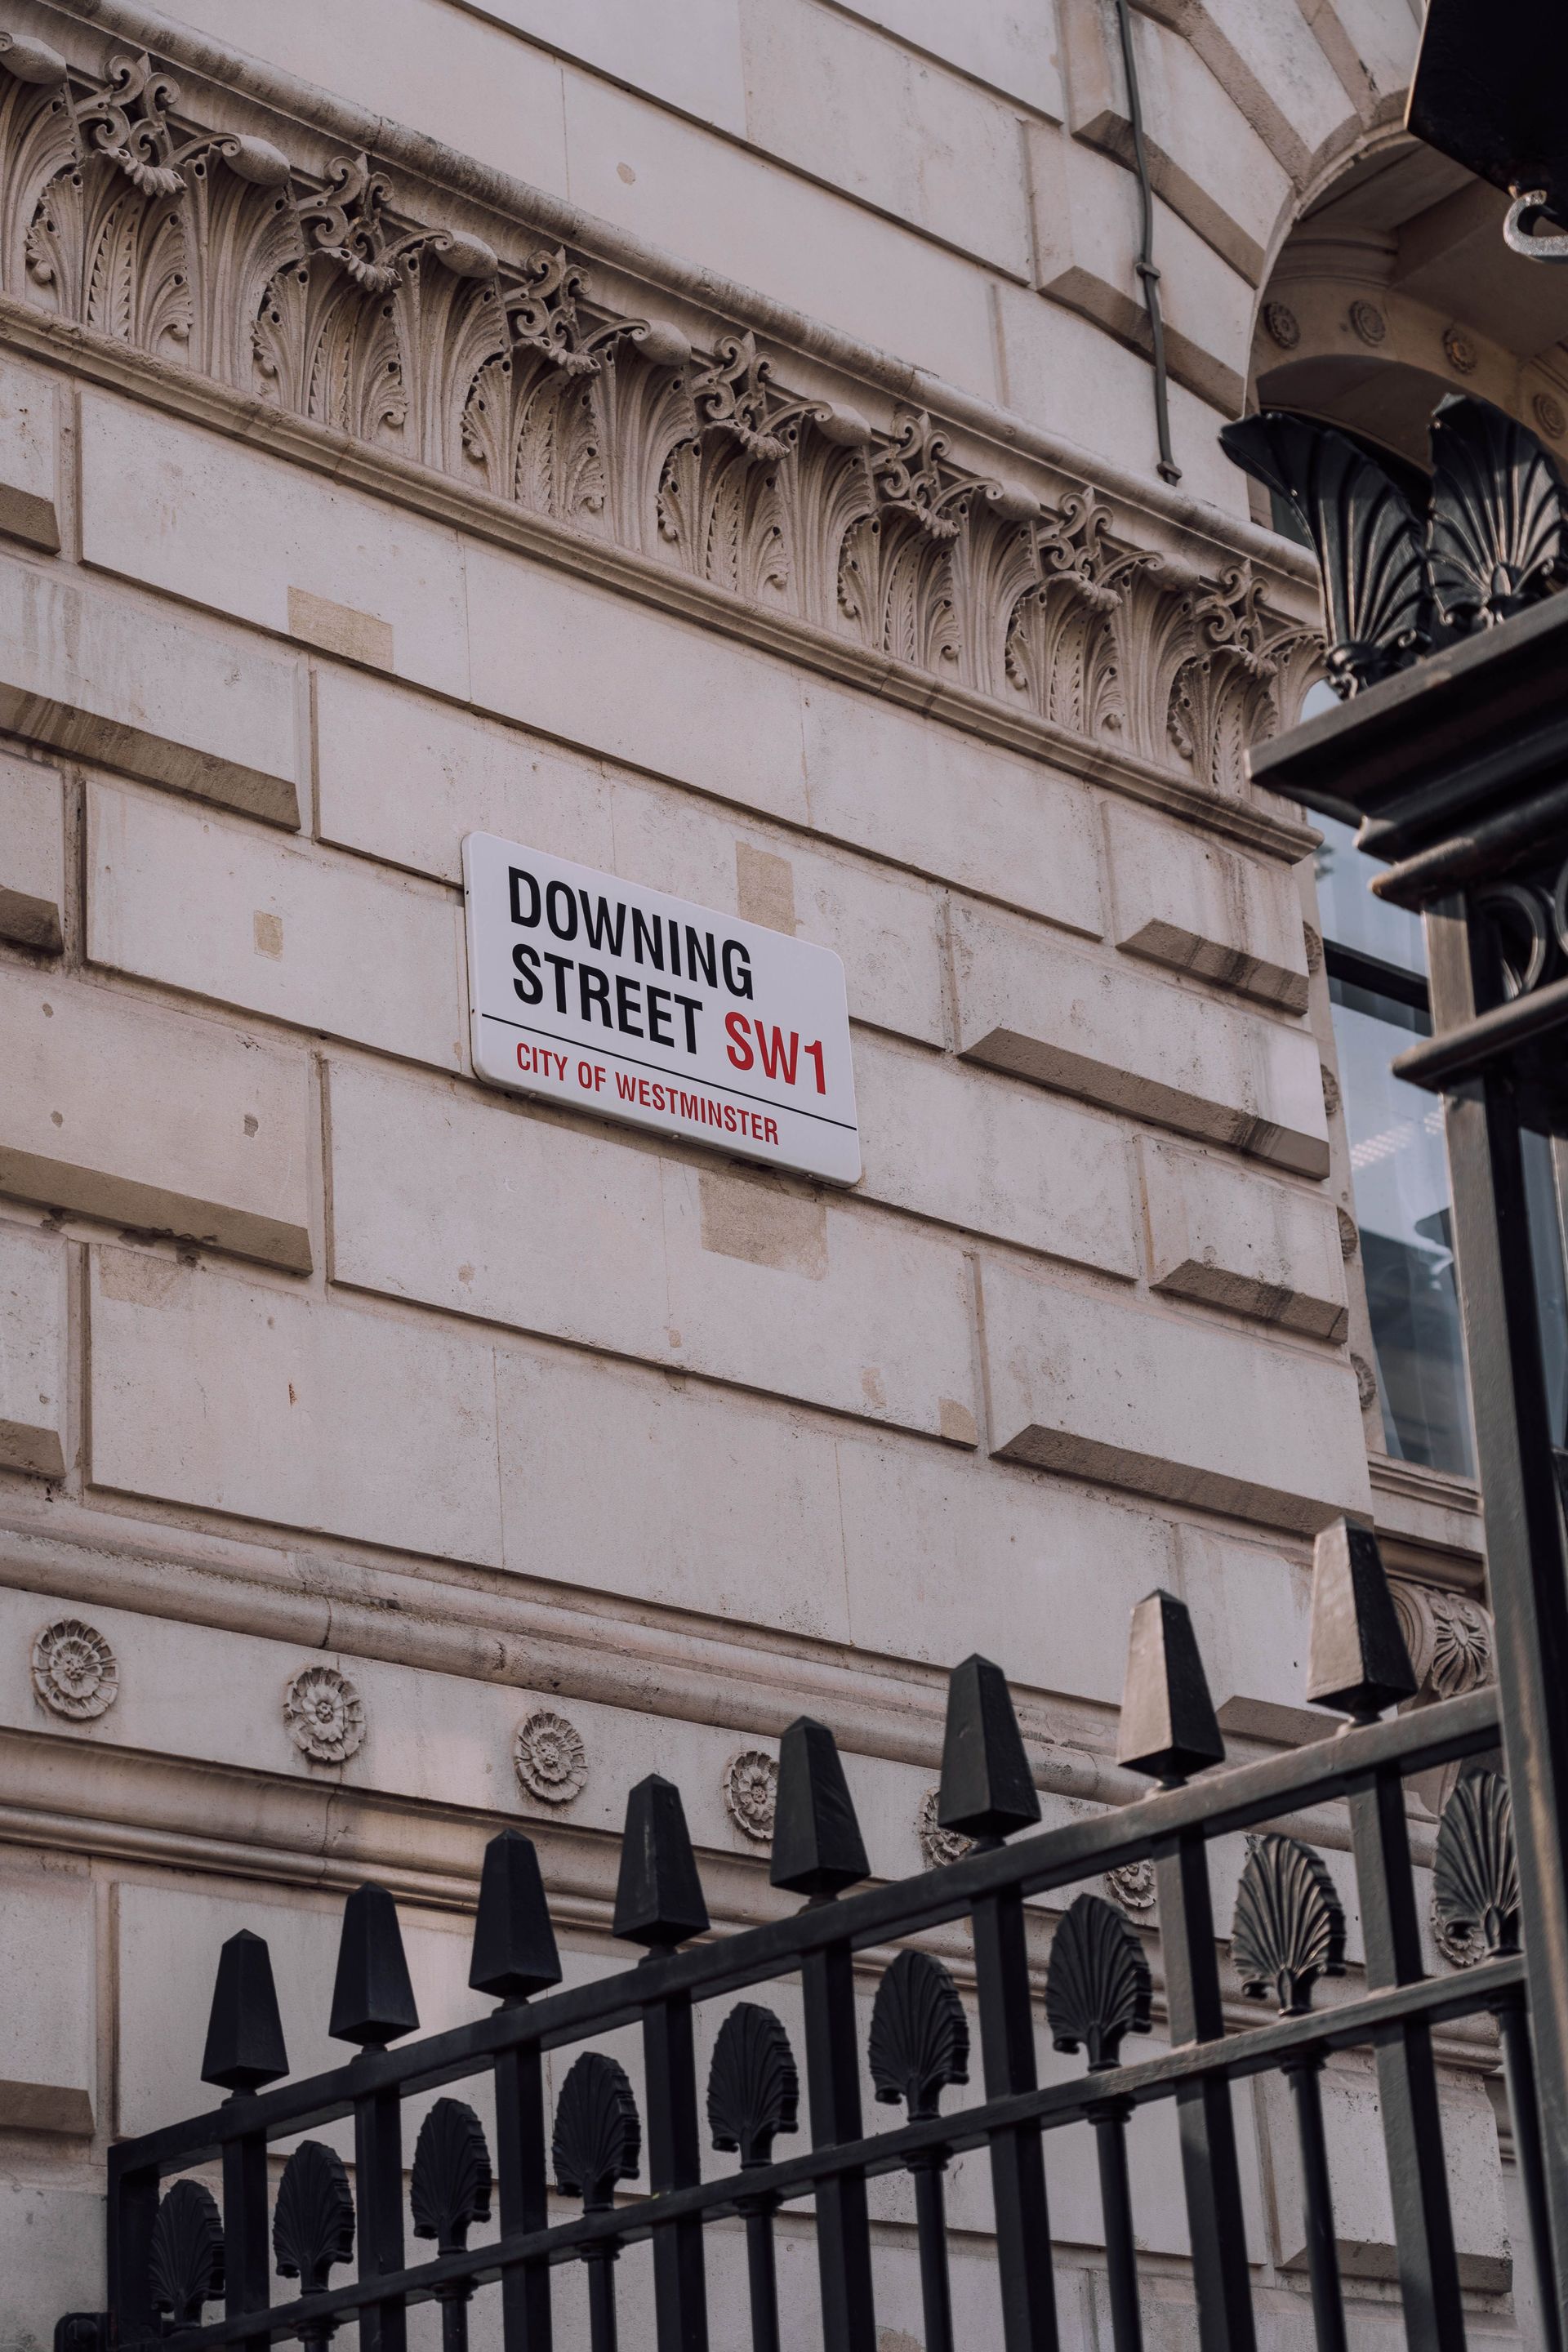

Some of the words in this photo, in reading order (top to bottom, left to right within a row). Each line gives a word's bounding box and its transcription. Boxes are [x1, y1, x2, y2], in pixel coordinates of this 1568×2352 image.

[508, 866, 754, 1000] DOWNING
[511, 943, 703, 1055] STREET
[724, 1011, 826, 1095] SW1
[515, 1042, 568, 1081] CITY
[577, 1061, 607, 1092] OF
[615, 1071, 779, 1145] WESTMINSTER
